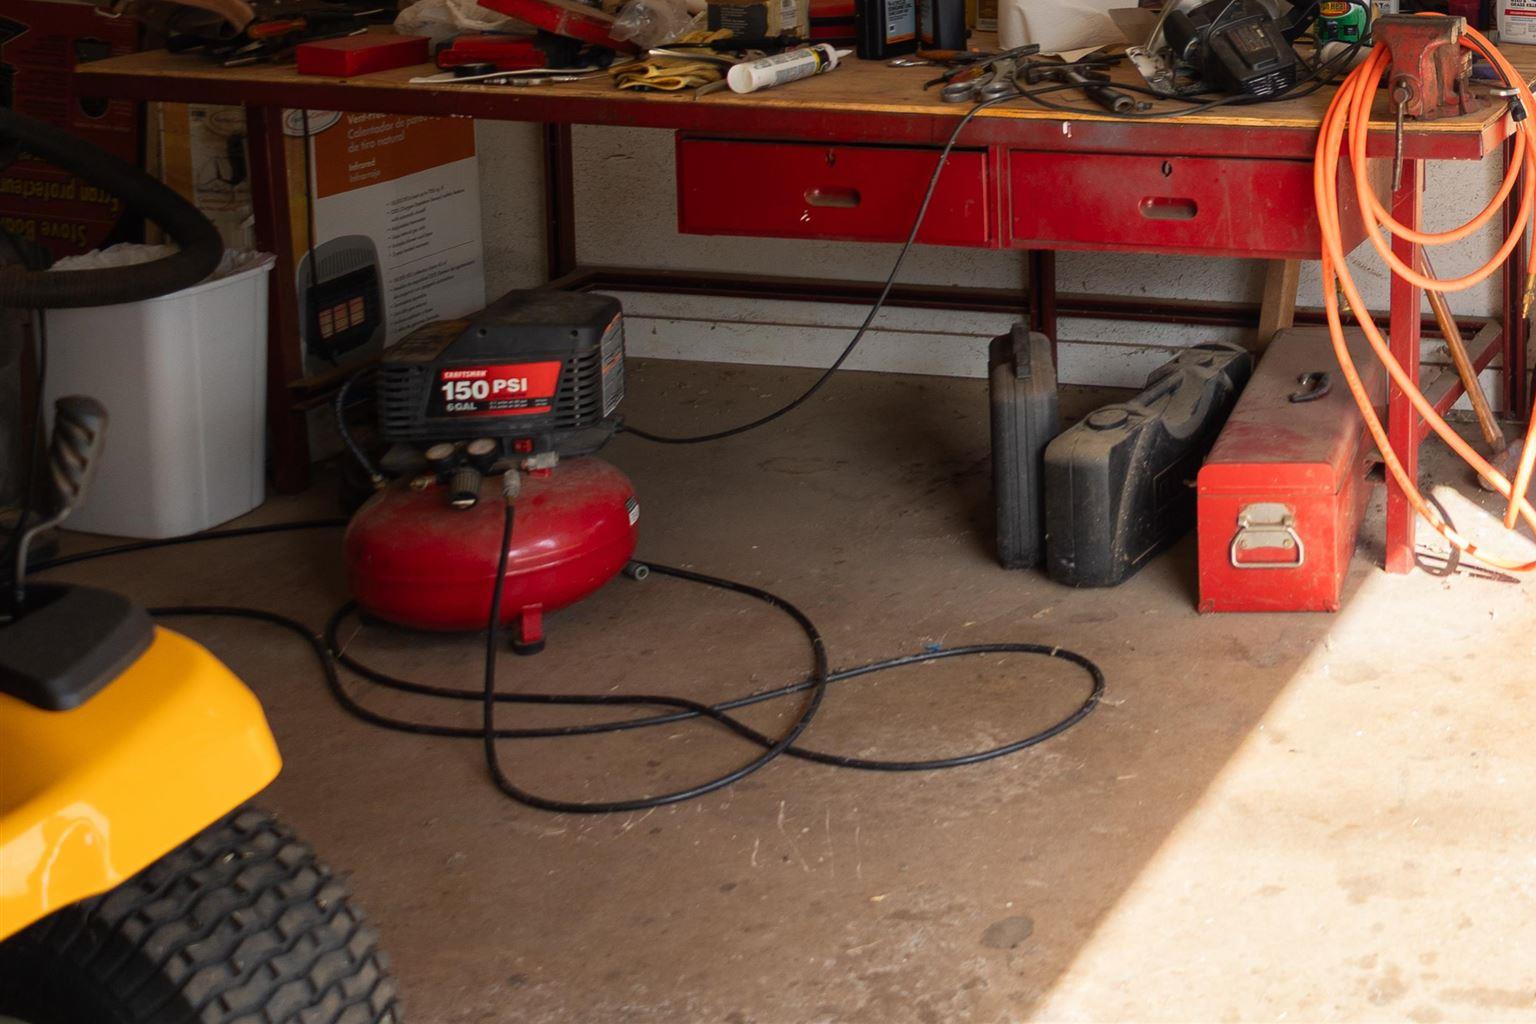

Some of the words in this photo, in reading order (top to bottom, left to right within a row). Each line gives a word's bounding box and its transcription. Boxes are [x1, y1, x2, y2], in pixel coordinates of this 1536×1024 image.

[40, 221, 88, 248] Stove
[441, 379, 490, 401] 150
[492, 377, 528, 394] PSI
